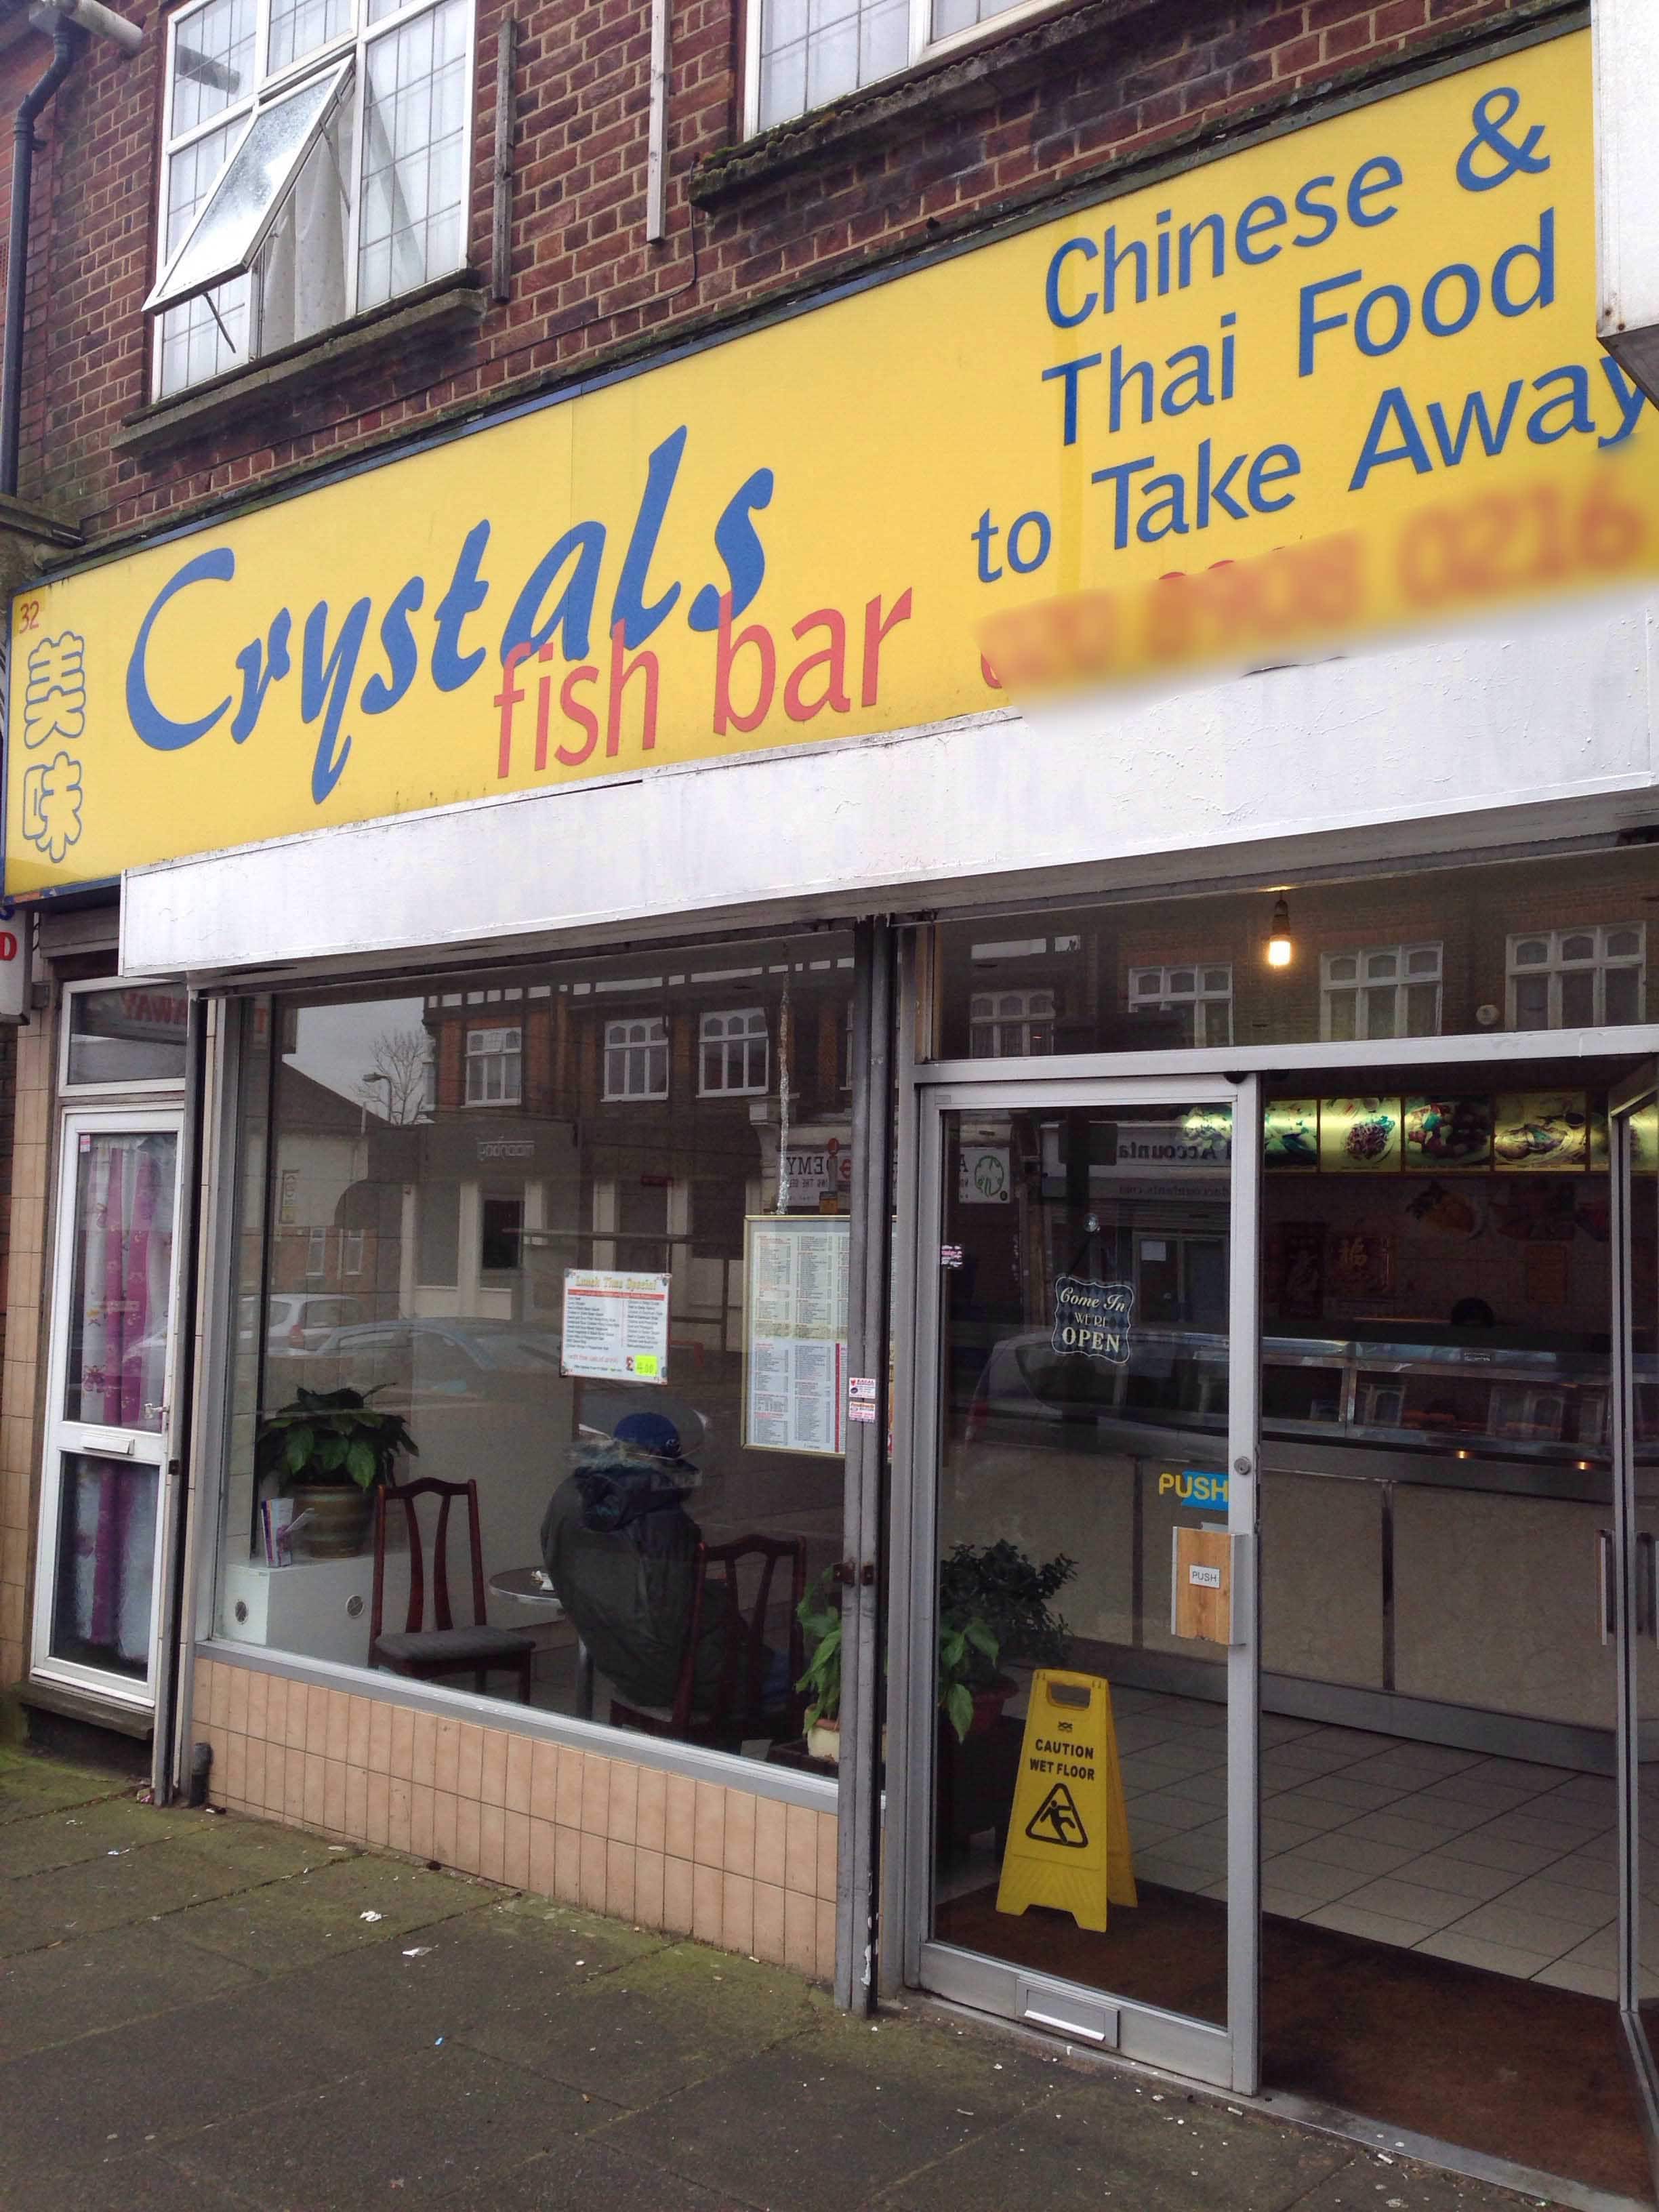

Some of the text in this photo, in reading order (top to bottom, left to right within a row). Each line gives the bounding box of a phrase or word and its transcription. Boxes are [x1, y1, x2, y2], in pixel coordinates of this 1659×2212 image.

[1046, 87, 1551, 328] Chinese &
[1042, 207, 1555, 446] Thai Food
[971, 356, 1647, 583] to Take Away
[19, 600, 40, 633] 32
[126, 425, 775, 804] Crystals
[493, 617, 660, 779] fish
[712, 587, 913, 736] bar
[22, 630, 86, 863] 美味
[1060, 1287, 1126, 1313] Come In
[1061, 1326, 1121, 1353] OPEN
[1158, 1473, 1229, 1502] PUSH
[1191, 1570, 1218, 1582] PUSH
[1035, 1738, 1094, 1760] CAUTION
[1029, 1757, 1096, 1782] WET FLOOR
